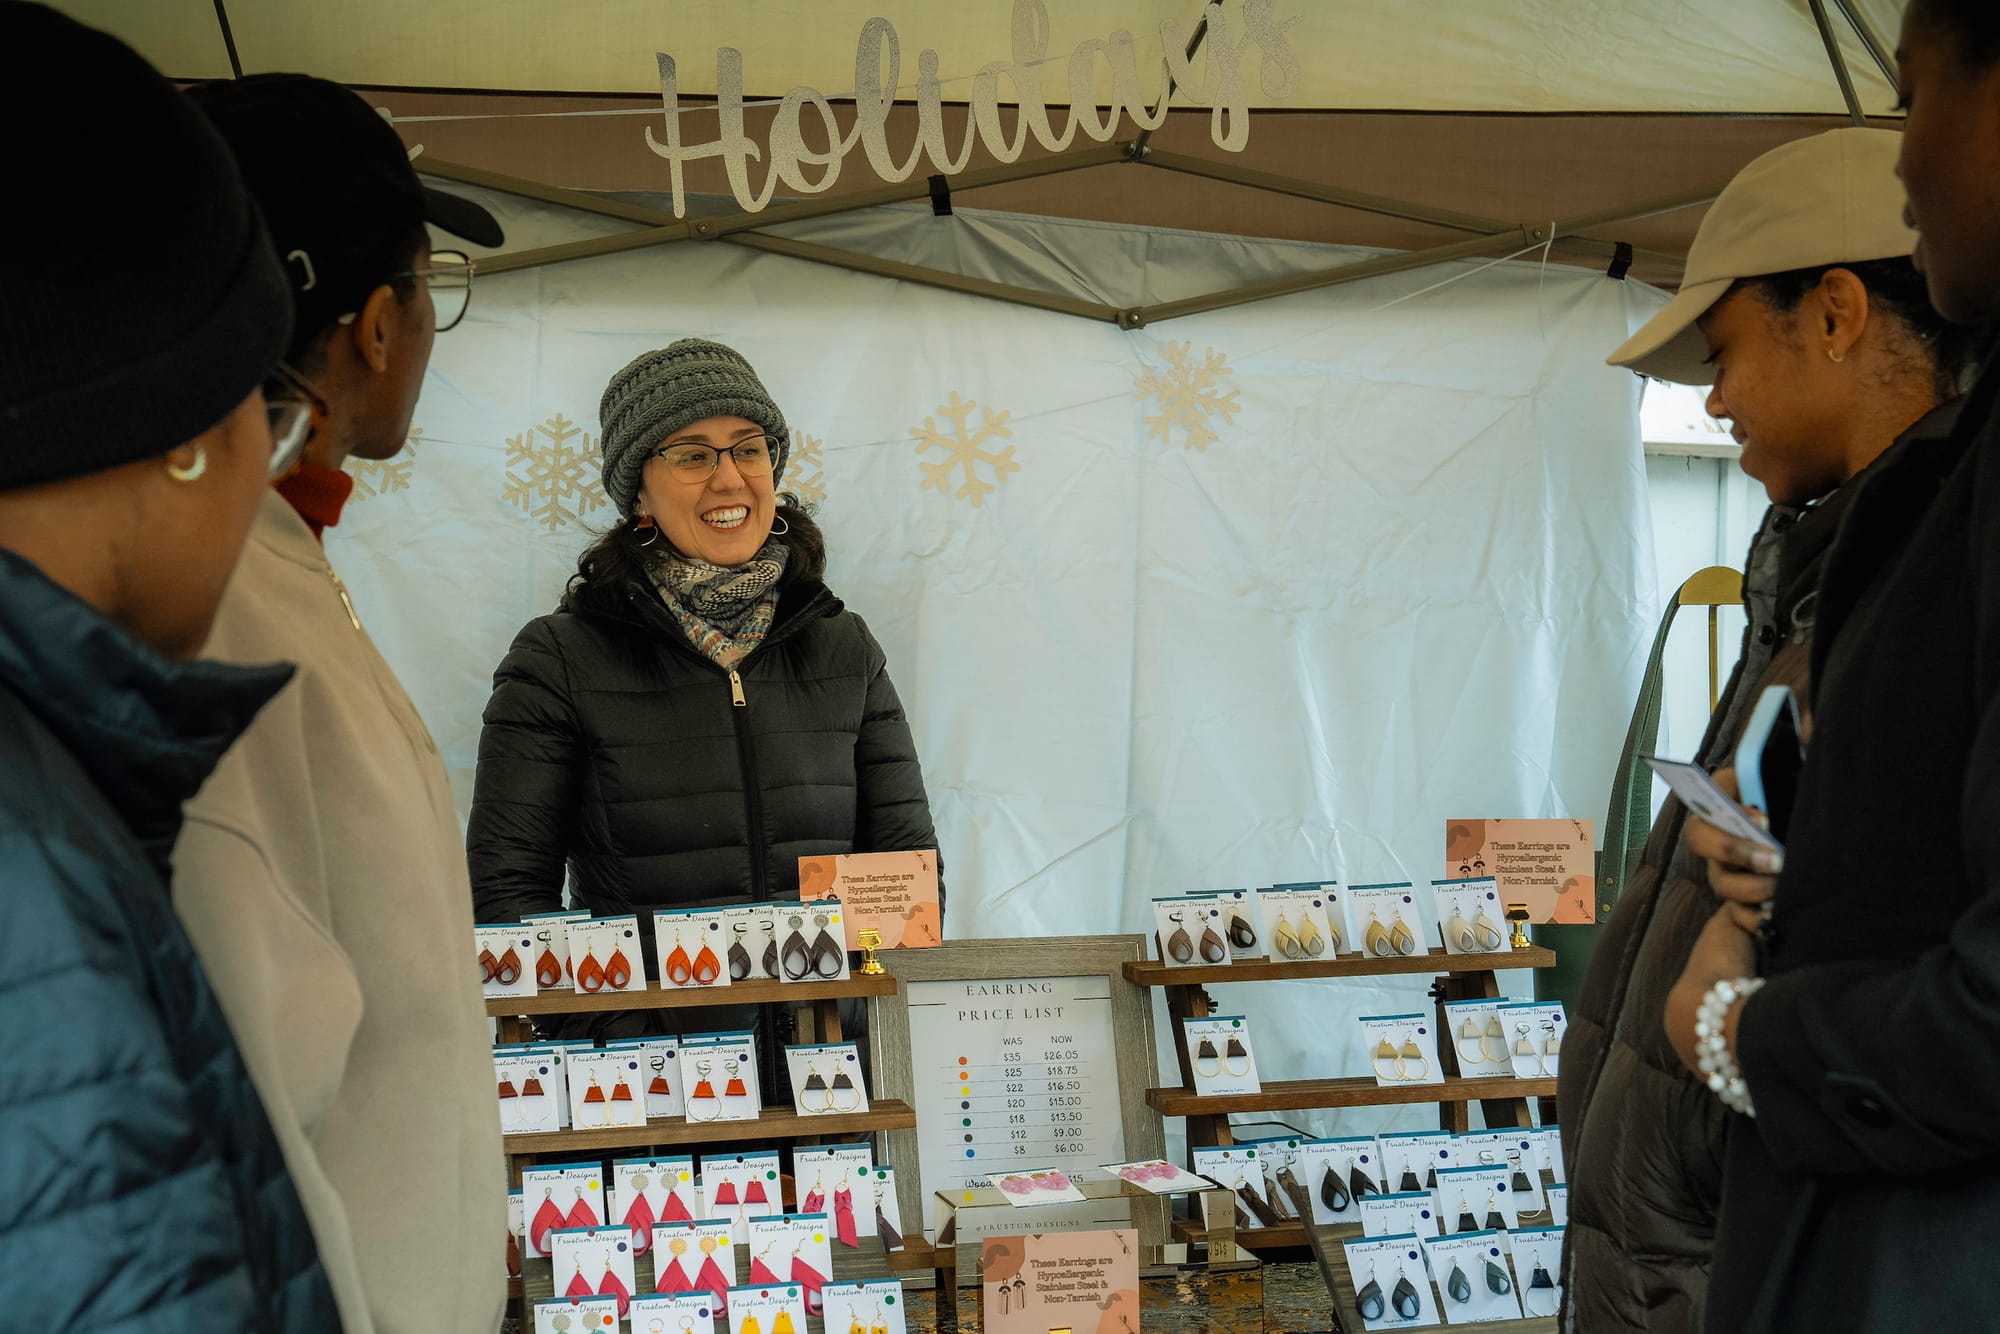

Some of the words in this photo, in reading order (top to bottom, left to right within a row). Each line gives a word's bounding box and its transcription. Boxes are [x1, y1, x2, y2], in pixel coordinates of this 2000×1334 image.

[645, 0, 1303, 218] Holidays
[1490, 842, 1516, 850] These
[1517, 842, 1554, 852] Earrings
[1496, 854, 1562, 863] Hypoallergenic
[1495, 865, 1533, 874] Stainless
[1534, 865, 1556, 873] Steel
[1558, 865, 1566, 873] &
[841, 876, 864, 884] These
[866, 874, 900, 883] Earrings
[1502, 876, 1558, 885] Non-Tarnish
[848, 884, 908, 895] Hypoallergenic
[847, 896, 882, 904] Stainless
[904, 894, 911, 902] &
[754, 908, 774, 916] Desig
[778, 908, 804, 916] Frustum
[854, 905, 904, 914] Non-Tarnish
[659, 916, 688, 924] Frustum
[692, 915, 720, 923] Designs
[572, 924, 600, 932] Frustum
[605, 921, 633, 930] Designs
[501, 928, 530, 937] Designs
[966, 982, 1053, 996] EARRING
[958, 1008, 1014, 1022] PRICE
[1024, 1006, 1064, 1019] LIST
[646, 1042, 674, 1050] Designs
[1003, 1037, 1023, 1046] WAS
[1051, 1036, 1072, 1044] NOW
[606, 1053, 636, 1062] Designs
[1004, 1052, 1021, 1062] $35
[1044, 1050, 1078, 1060] $26.05
[495, 1058, 516, 1066] ustum
[520, 1058, 550, 1066] Designs
[1004, 1068, 1022, 1078] $25
[1047, 1066, 1078, 1076] $18.75
[1006, 1084, 1024, 1093] $22
[1047, 1082, 1080, 1092] $16.50
[1007, 1099, 1025, 1109] $20
[1048, 1097, 1082, 1106] $15.00
[1009, 1114, 1025, 1124] $18
[1050, 1112, 1082, 1122] $13.50
[1010, 1130, 1026, 1140] $12
[1054, 1128, 1082, 1138] $9.00
[1499, 1134, 1528, 1142] Designs
[1386, 1140, 1415, 1148] Frustum
[1419, 1138, 1447, 1146] Designs
[1014, 1145, 1026, 1156] $8
[1054, 1143, 1084, 1154] $6.00
[1306, 1146, 1336, 1154] Frustum
[1340, 1145, 1369, 1153] Designs
[800, 1154, 832, 1162] Frustum
[835, 1152, 866, 1161] Designs
[1200, 1158, 1228, 1166] Frustum
[1230, 1157, 1256, 1165] Designs
[620, 1166, 653, 1175] Frustum
[656, 1165, 688, 1174] Designs
[743, 1160, 774, 1170] Designs
[528, 1173, 562, 1182] Frustum
[566, 1170, 598, 1181] Designs
[1476, 1173, 1505, 1182] Designs
[873, 1178, 890, 1186] signs
[1365, 1202, 1396, 1211] Frustum
[1400, 1200, 1428, 1210] Designs
[755, 1224, 788, 1233] Frustum
[792, 1222, 824, 1231] Designs
[1036, 1220, 1080, 1228] DESIGNS
[658, 1230, 692, 1238] Frustum
[696, 1228, 727, 1236] Designs
[557, 1236, 592, 1245] Frustum
[594, 1234, 627, 1243] Designs
[1514, 1235, 1544, 1244] Frustum
[1351, 1245, 1380, 1254] Frustum
[1385, 1242, 1415, 1252] Designs
[1432, 1243, 1462, 1252] Frustum
[1466, 1240, 1496, 1250] Designs
[1030, 1260, 1056, 1268] These
[1058, 1258, 1097, 1268] Earrings
[1037, 1269, 1104, 1280] Hypoallergenic
[828, 1288, 862, 1297] Frustum
[865, 1286, 897, 1296] Designs
[1036, 1282, 1076, 1292] Stainless
[1077, 1282, 1099, 1290] Steel
[732, 1300, 765, 1308] Frustum
[768, 1297, 799, 1306] Designs
[1044, 1293, 1100, 1304] Non-Tarnish
[540, 1306, 575, 1316] Frustum
[580, 1304, 612, 1313] Designs
[636, 1302, 670, 1311] Frustum
[674, 1300, 707, 1310] Designs
